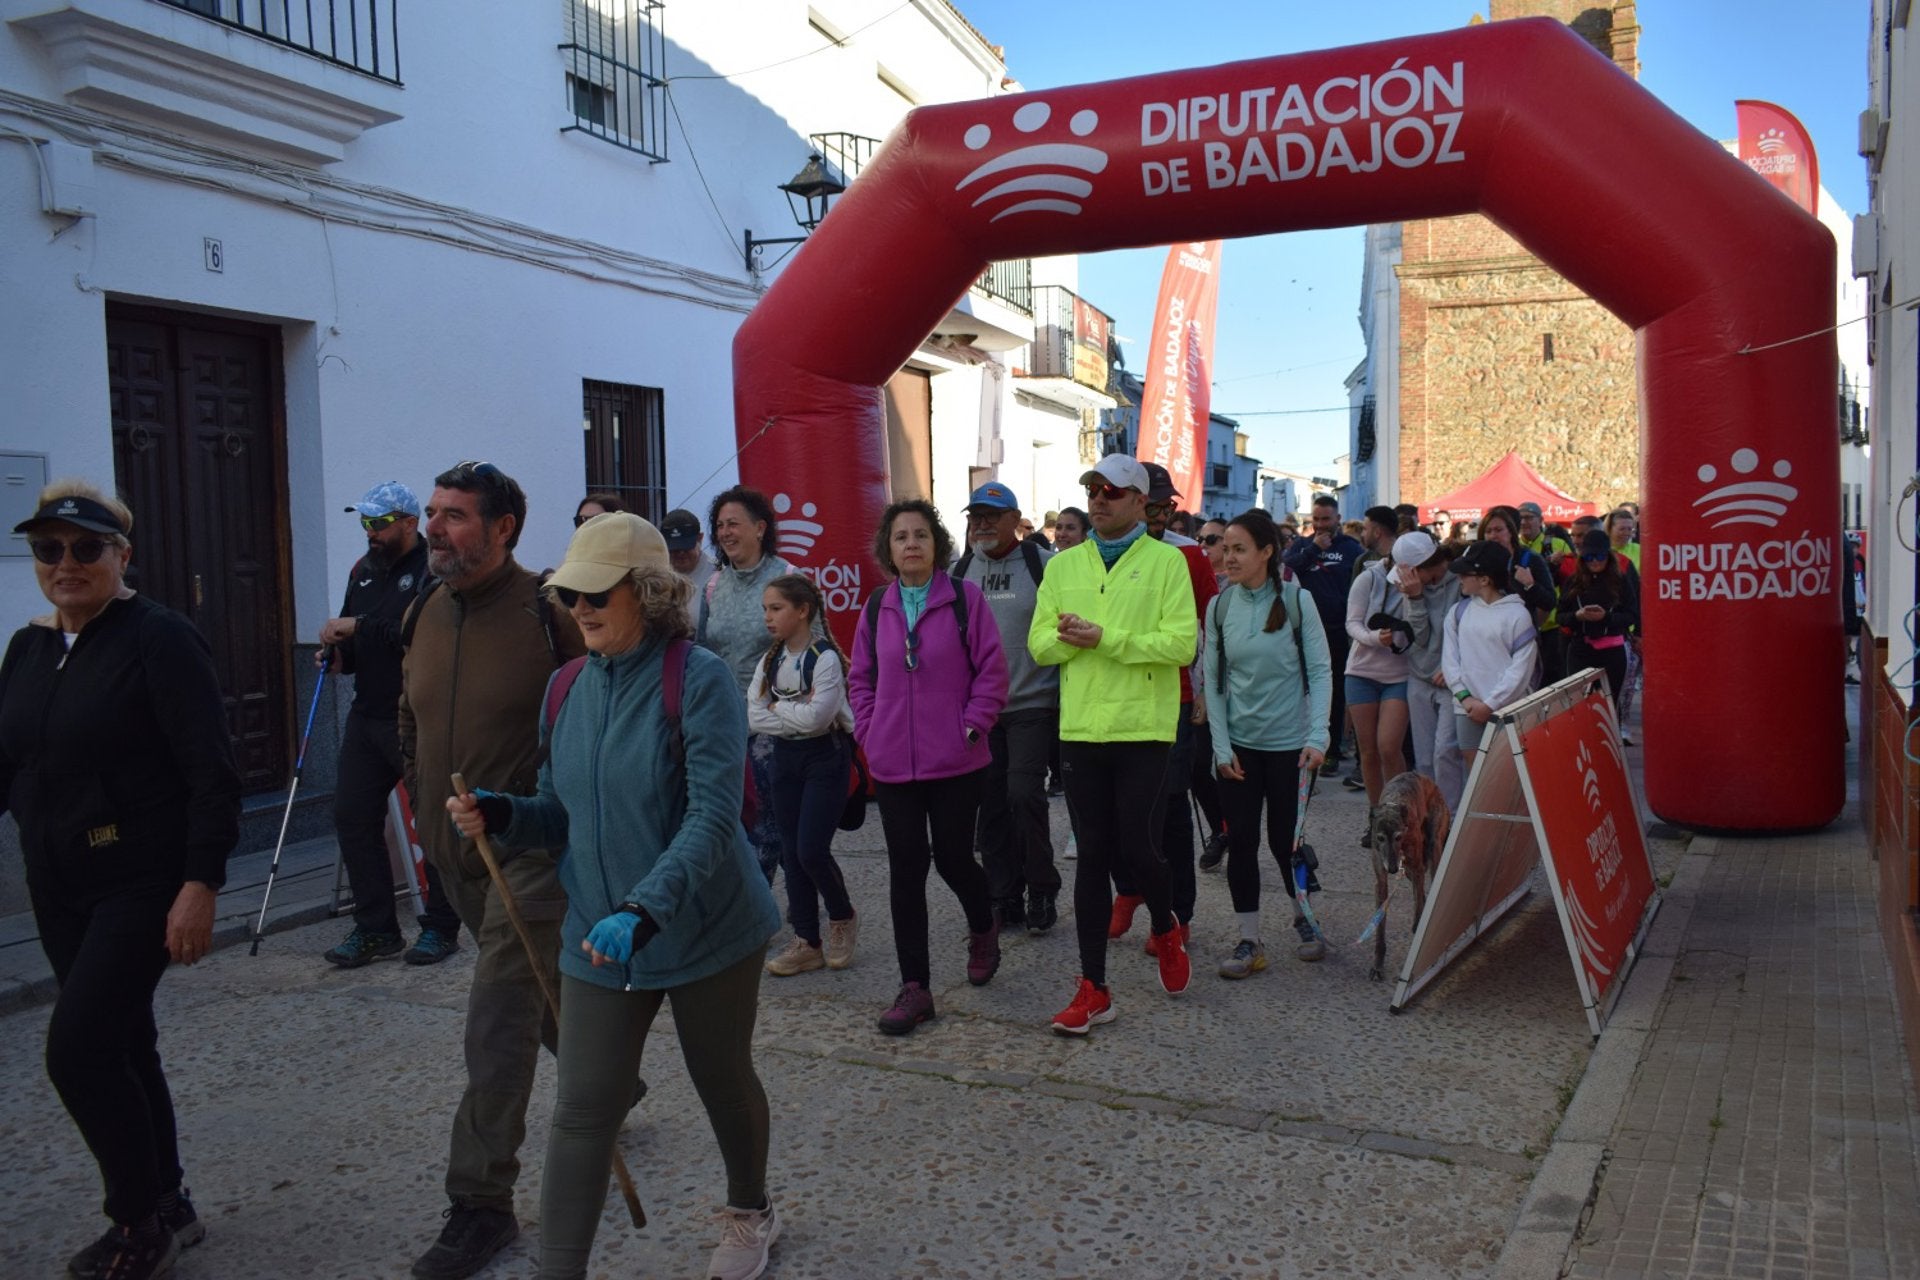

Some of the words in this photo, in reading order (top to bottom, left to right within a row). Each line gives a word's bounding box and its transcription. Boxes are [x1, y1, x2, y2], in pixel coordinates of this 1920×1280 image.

[1141, 57, 1464, 146] DIPUTACIÓN
[1141, 158, 1191, 196] DE
[1204, 111, 1465, 189] BADAJOZ
[211, 243, 220, 268] 6
[1164, 297, 1185, 377] BADAJOZ
[1166, 381, 1176, 397] DE
[1154, 399, 1176, 469] TACIÓN
[1658, 530, 1831, 571] DIPUTACIÓN
[1659, 579, 1681, 599] DE
[1690, 566, 1831, 600] BADAJOZ
